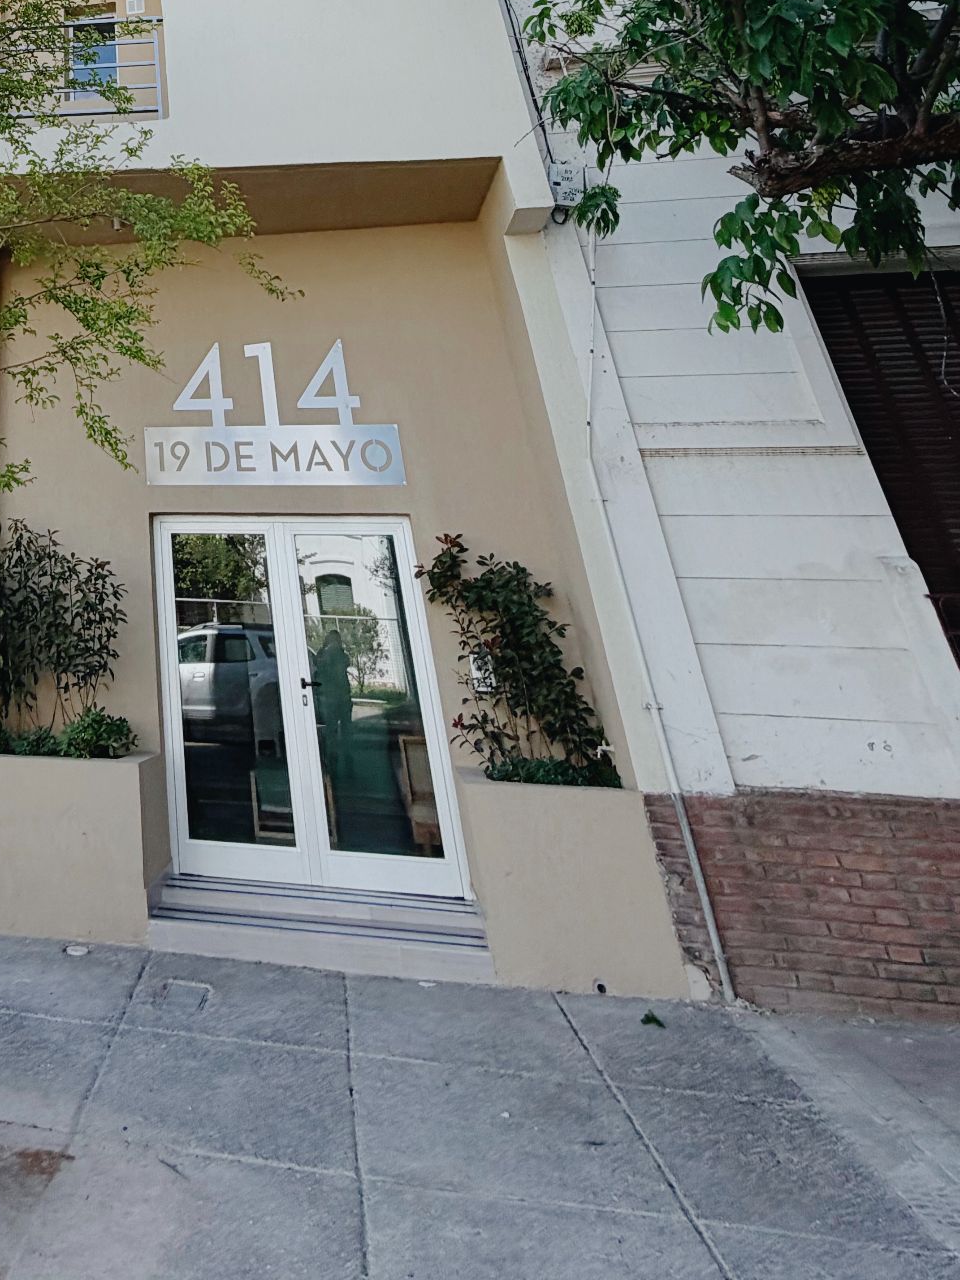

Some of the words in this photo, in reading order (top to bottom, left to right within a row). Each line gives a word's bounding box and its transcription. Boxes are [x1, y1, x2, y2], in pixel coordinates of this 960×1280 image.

[172, 338, 361, 426] 414
[154, 441, 190, 472] 19
[205, 441, 257, 472] DE
[269, 439, 393, 472] MAYO
